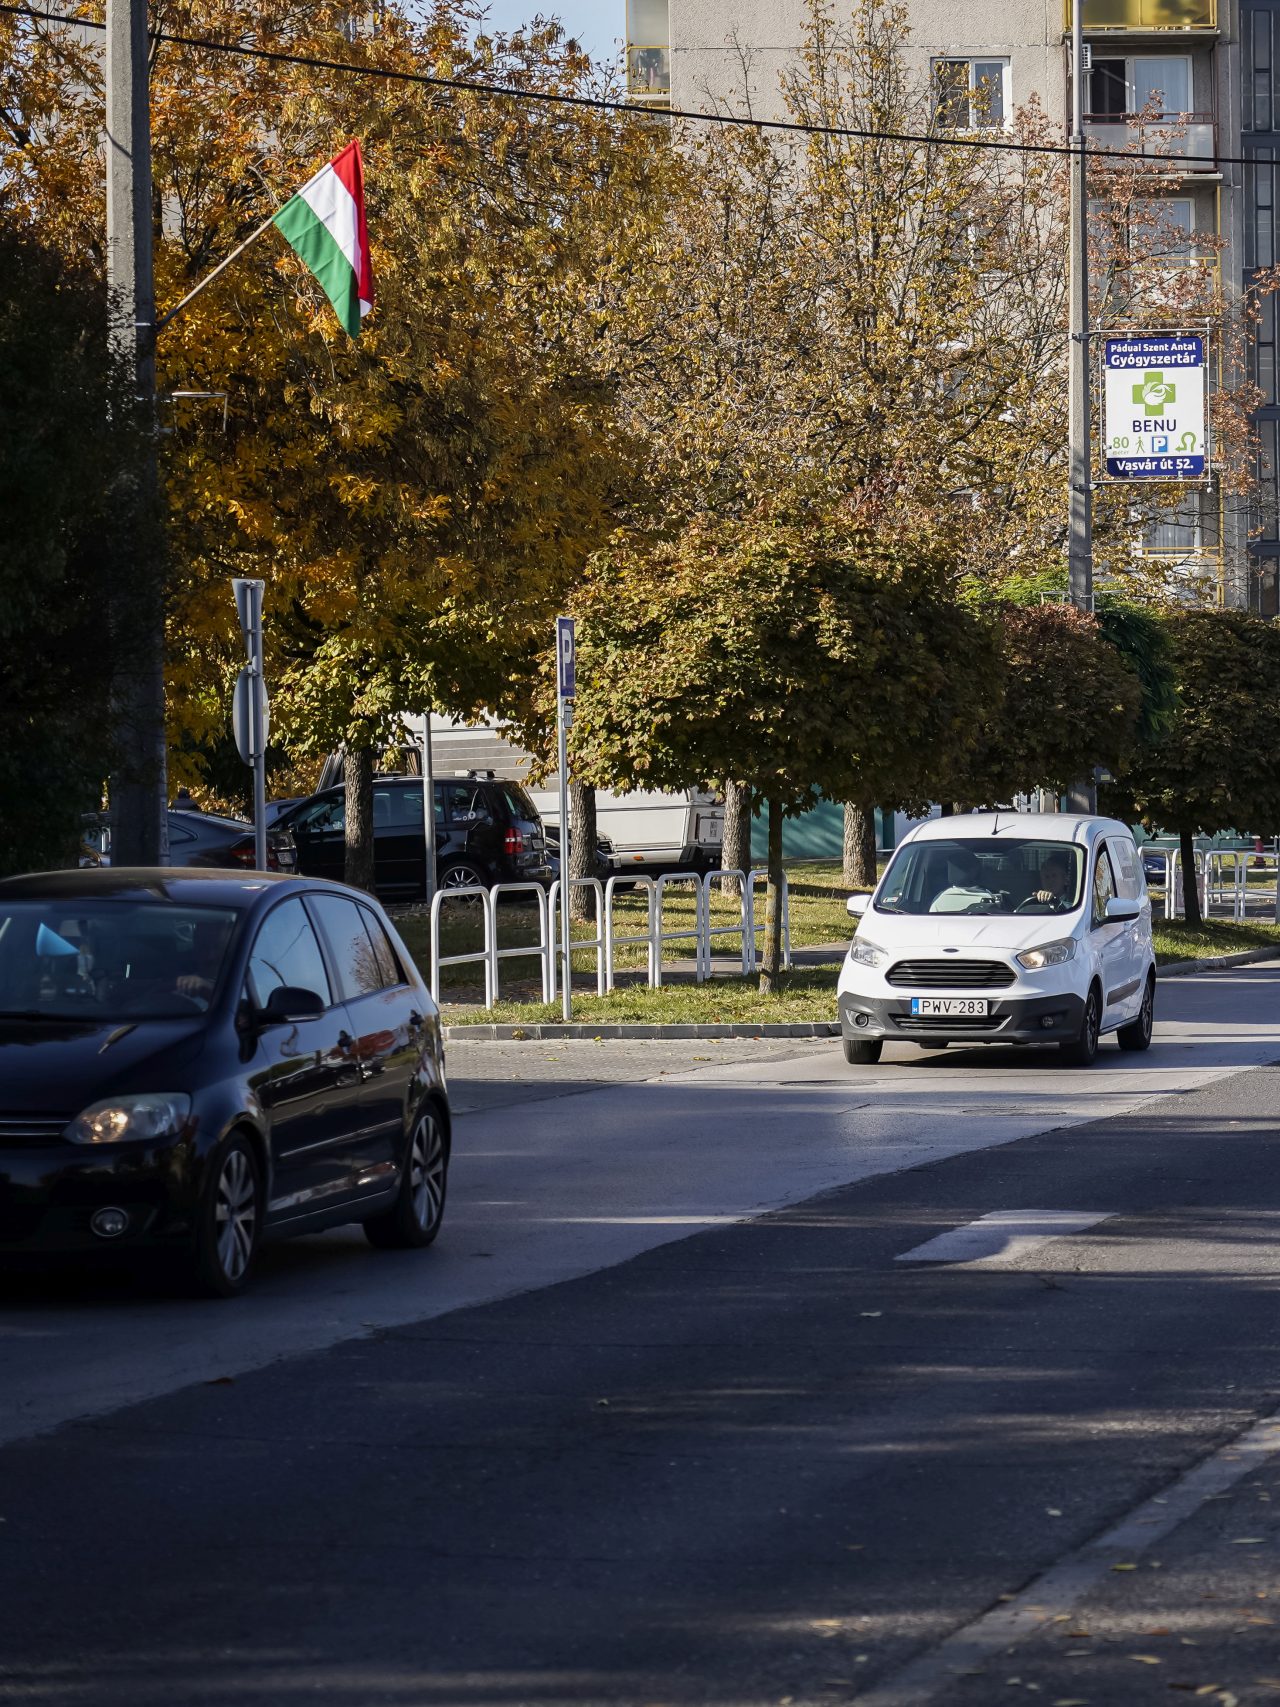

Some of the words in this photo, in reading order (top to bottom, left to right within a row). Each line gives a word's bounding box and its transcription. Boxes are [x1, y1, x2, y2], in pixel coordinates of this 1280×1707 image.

[1110, 343, 1141, 352] Páduai
[1143, 343, 1169, 352] Szent
[1171, 342, 1196, 351] Antal
[1110, 352, 1197, 367] Gyógyszertár
[1132, 419, 1177, 433] BENU
[1112, 436, 1130, 449] 80
[1116, 458, 1158, 471] Vasvár
[1160, 458, 1174, 470] út
[1176, 458, 1194, 470] 52.
[561, 628, 572, 687] P
[922, 1000, 984, 1014] PWV-283
